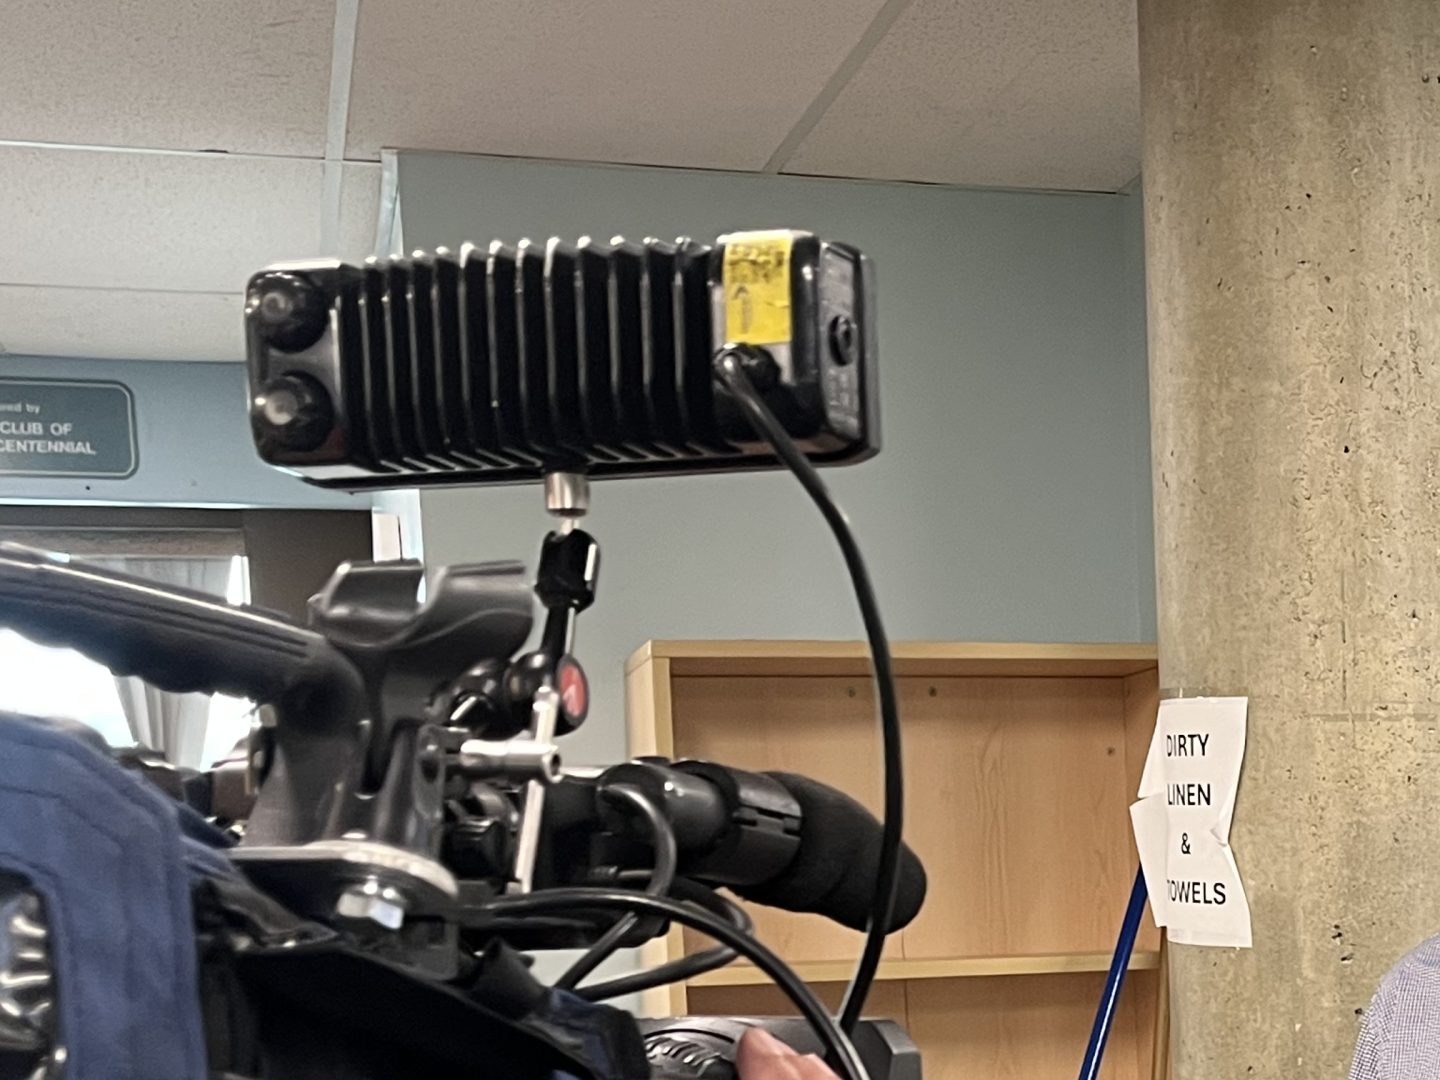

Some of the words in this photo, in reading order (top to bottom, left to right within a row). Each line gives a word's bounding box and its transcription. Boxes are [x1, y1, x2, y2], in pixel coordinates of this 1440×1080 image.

[0, 420, 43, 435] CLUB
[50, 422, 73, 436] OF
[1166, 733, 1209, 757] DIRTY
[1167, 783, 1211, 806] LINEN
[1181, 832, 1191, 855] &
